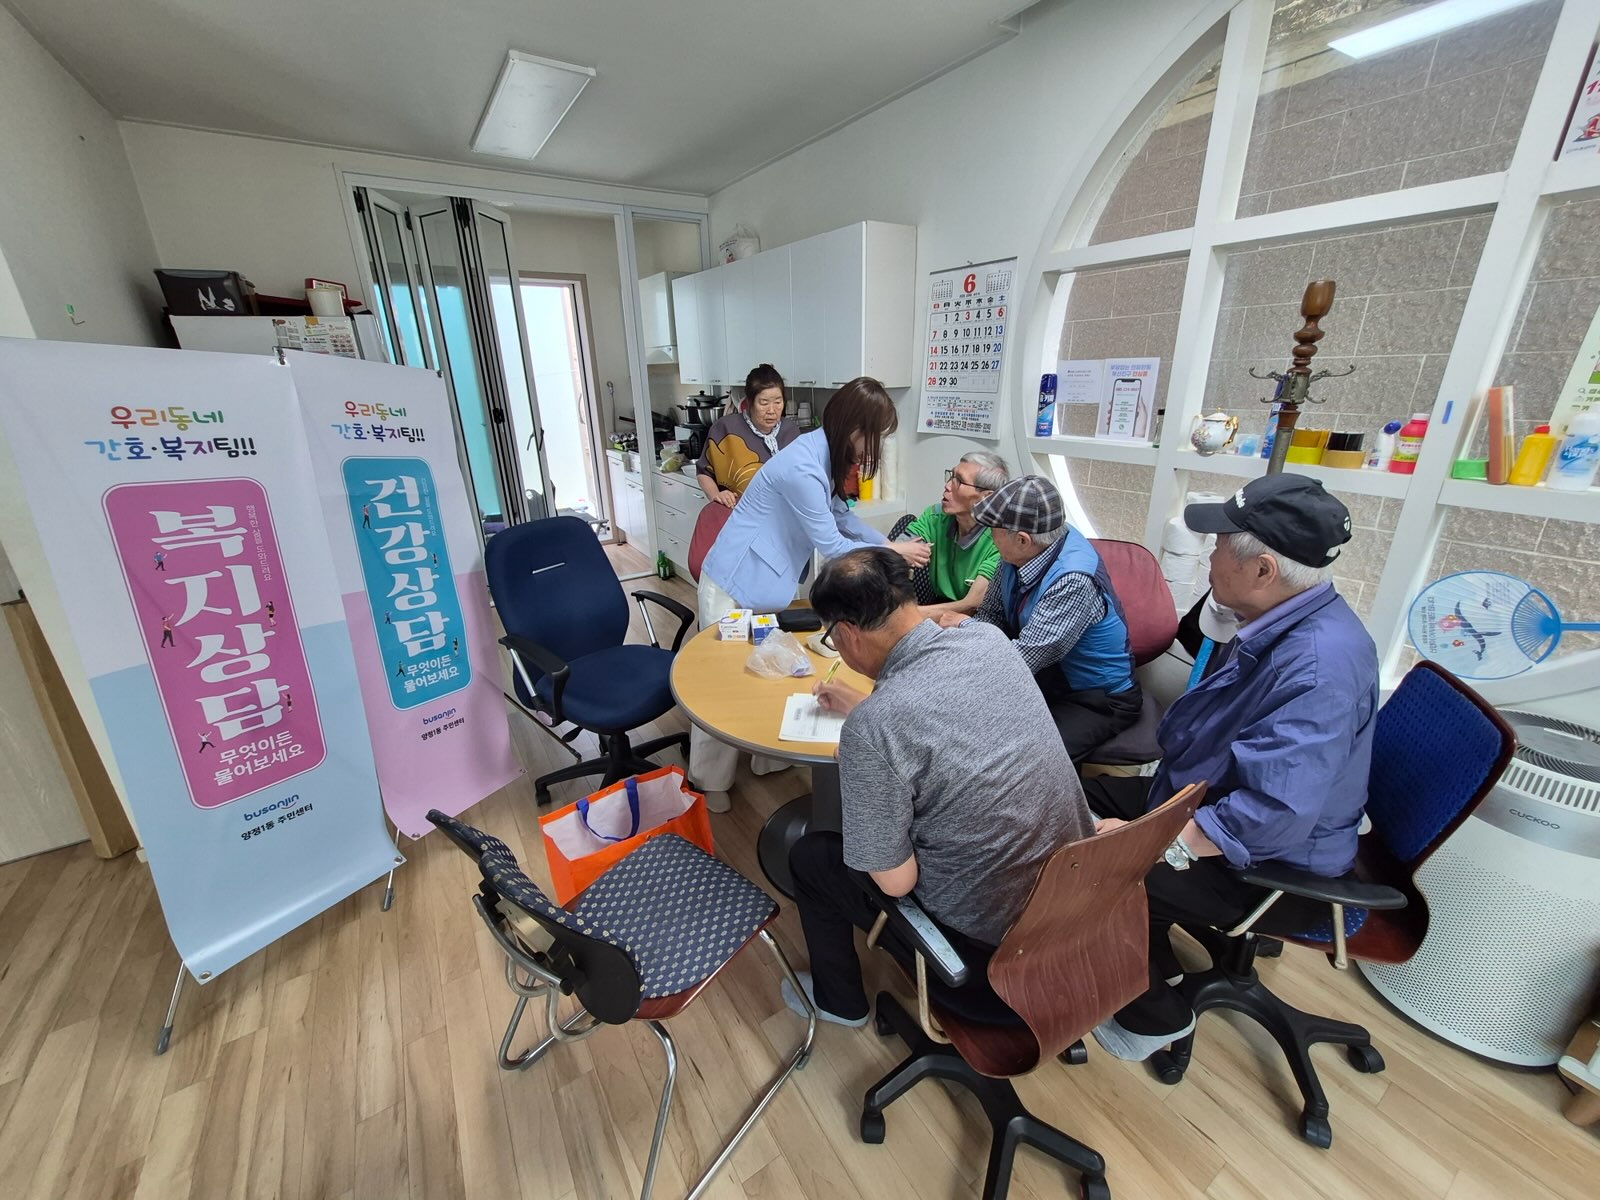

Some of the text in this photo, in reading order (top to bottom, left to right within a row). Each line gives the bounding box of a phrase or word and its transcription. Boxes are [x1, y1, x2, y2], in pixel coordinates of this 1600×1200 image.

[964, 273, 976, 294] 6
[944, 308, 1004, 322] 1 2 3 4 5 6
[933, 325, 1003, 339] 7 8 9 10 11 12 13
[941, 346, 948, 354] 15
[952, 345, 959, 354] 16
[962, 345, 969, 353] 17
[972, 344, 980, 353] 18
[983, 344, 990, 352] 19
[993, 343, 1001, 352] 20
[930, 362, 936, 370] 21
[940, 362, 947, 370] 22
[961, 361, 968, 369] 24
[971, 361, 979, 369] 25
[981, 361, 989, 369] 26
[991, 360, 999, 369] 27
[939, 377, 947, 385] 29
[949, 377, 957, 385] 30
[110, 405, 224, 431] 우리동네
[344, 400, 406, 421] 우리동네
[330, 423, 426, 443] 간호·복지팀!!
[84, 436, 257, 461] 간호·복지팀!!
[364, 475, 450, 658] 건강상담
[148, 505, 290, 741] 복지상담
[407, 654, 452, 676] 무엇이든
[403, 666, 460, 694] 물어보세요
[422, 708, 457, 725] busanjin
[421, 717, 465, 741] 양정1동 주민센터
[219, 730, 293, 765] 무엇이든
[213, 743, 305, 786] 물어보세요
[243, 794, 300, 822] busanjin
[1509, 808, 1561, 830] CUCKOO
[240, 802, 314, 841] 양정1동 주민센터
